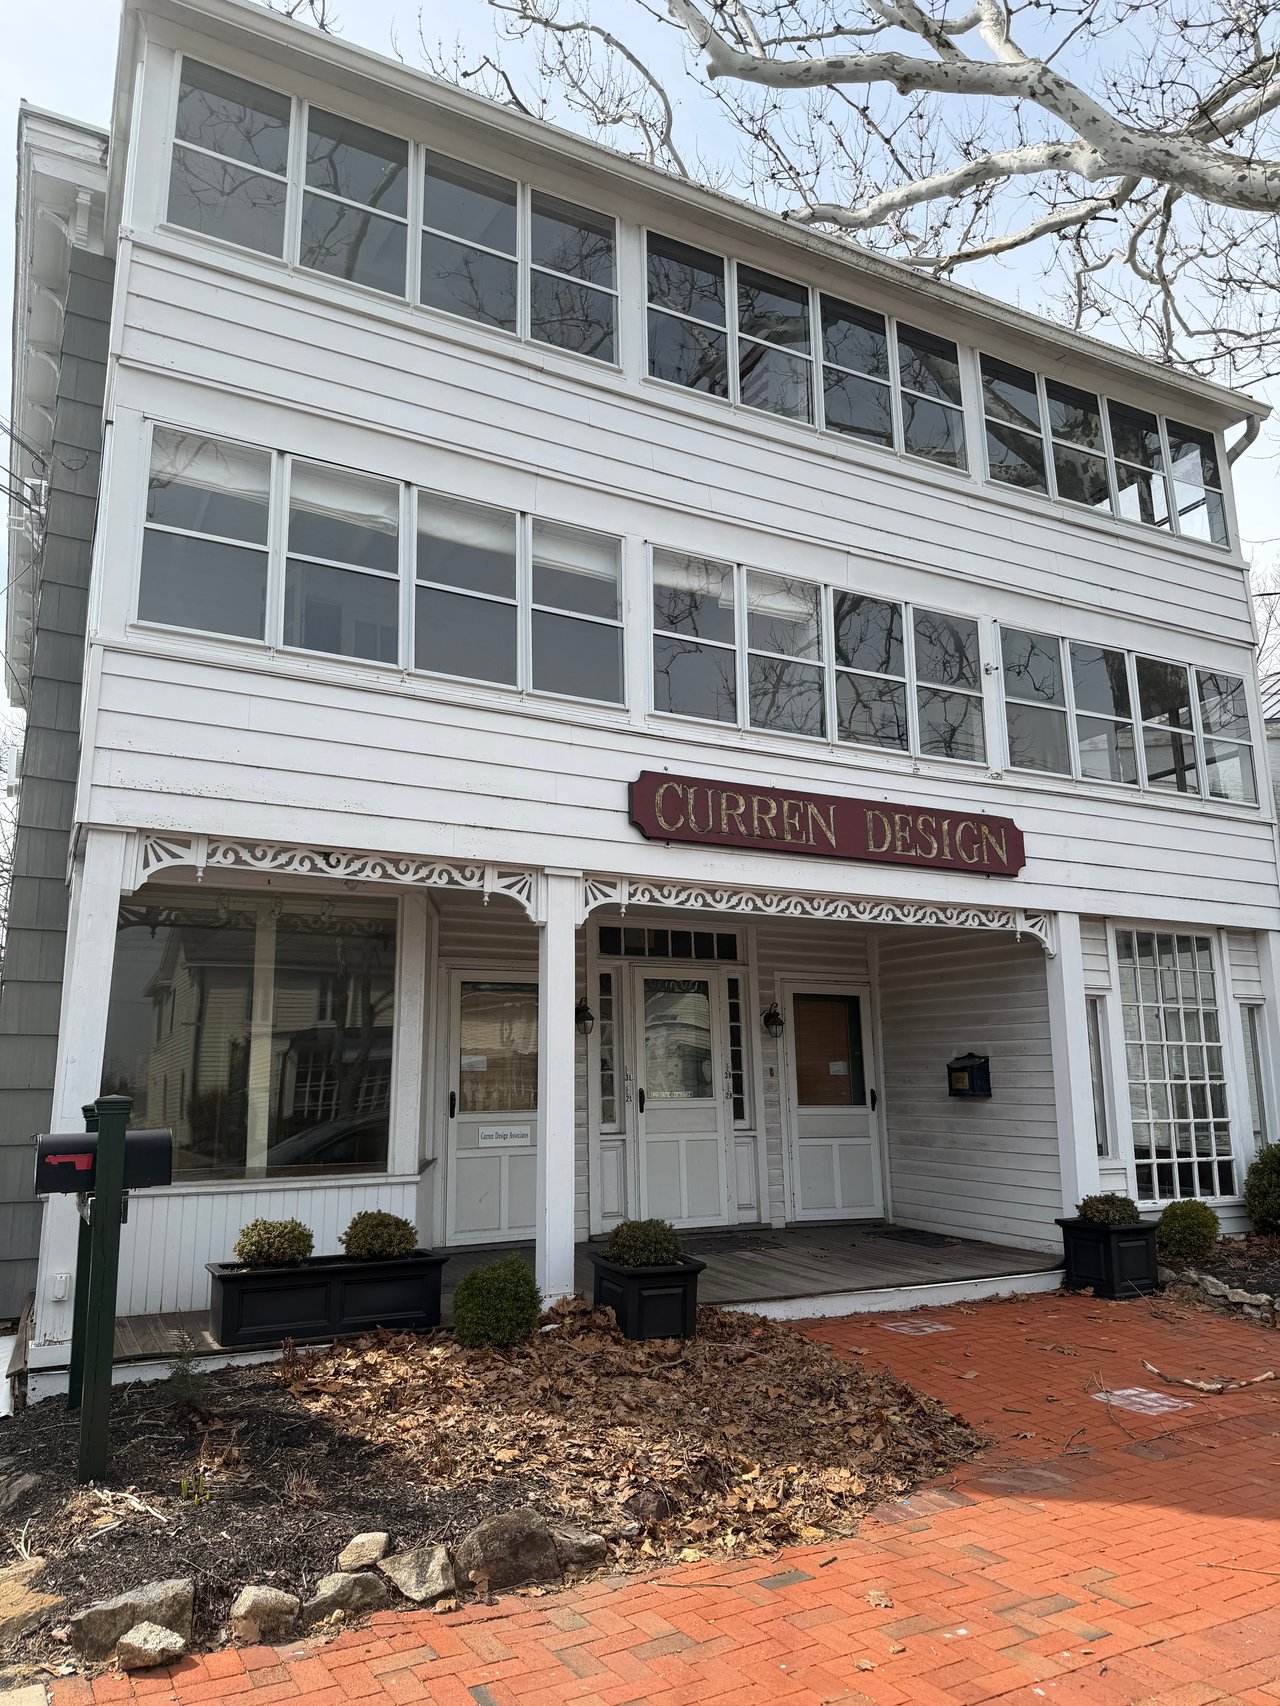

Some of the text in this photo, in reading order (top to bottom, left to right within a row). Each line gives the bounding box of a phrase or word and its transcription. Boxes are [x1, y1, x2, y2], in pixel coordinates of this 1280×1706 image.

[654, 780, 1009, 867] CURREN DESIGN
[495, 1131, 509, 1140] Design
[509, 1131, 529, 1139] Associates
